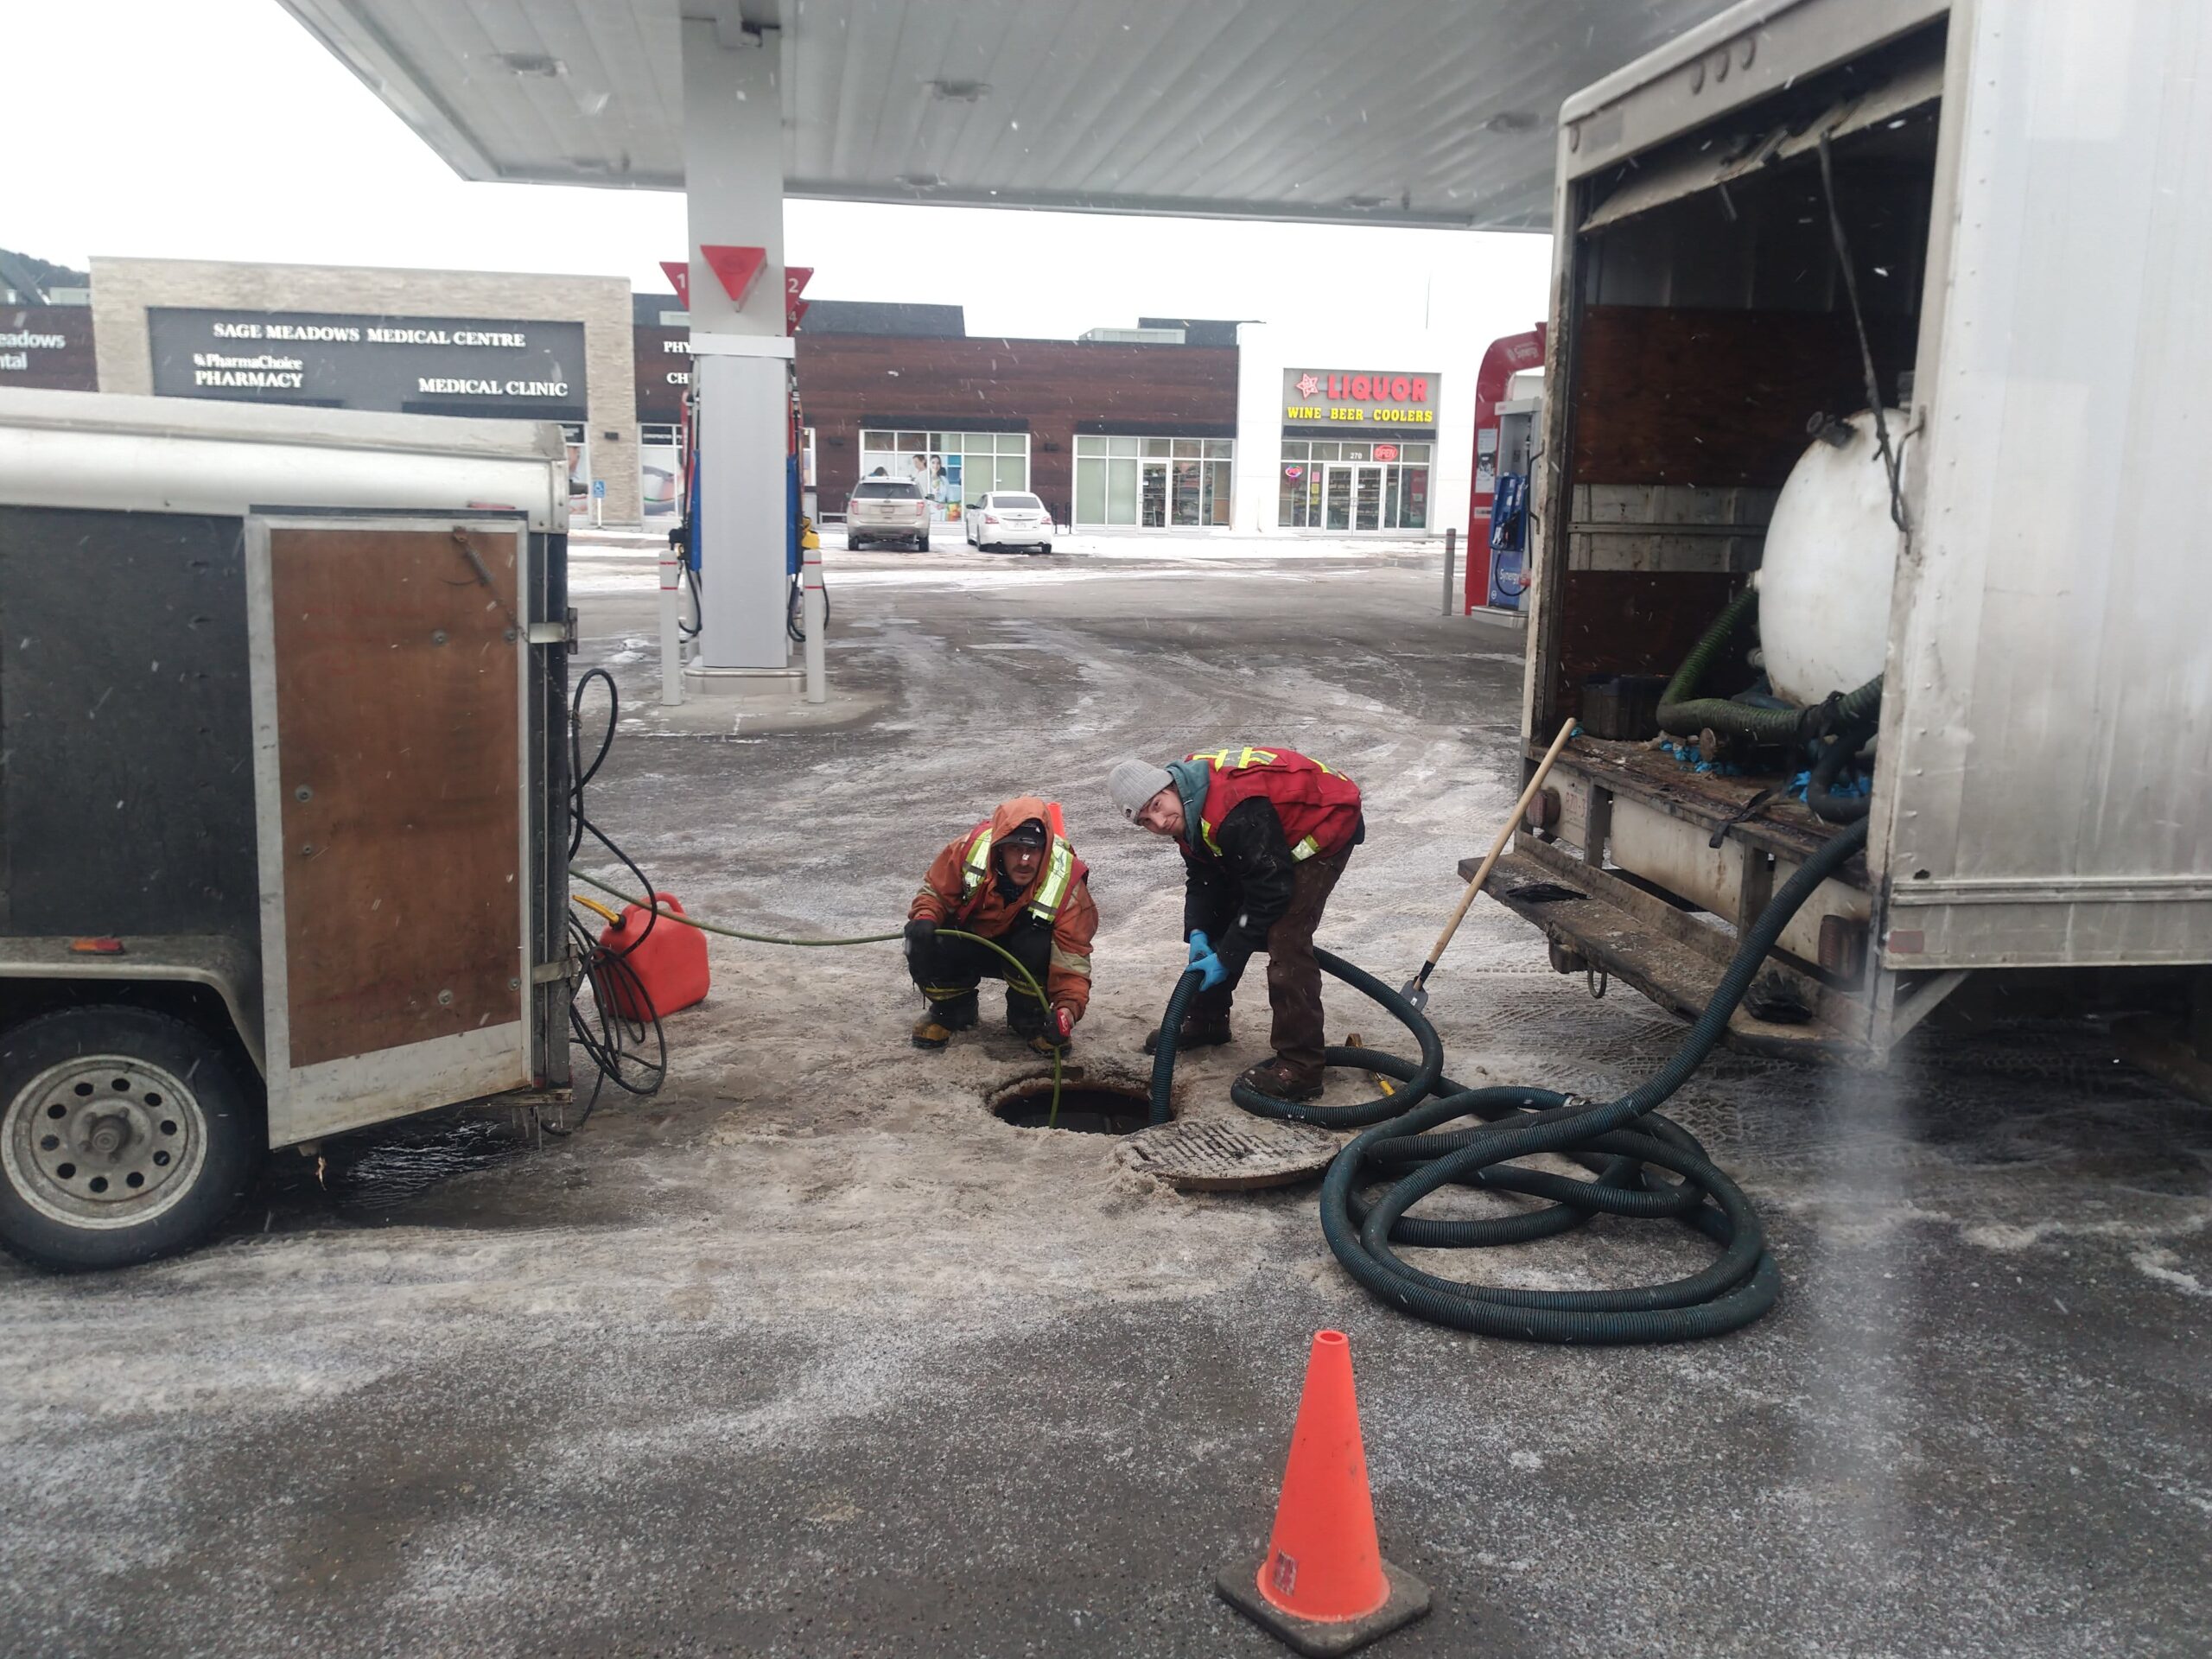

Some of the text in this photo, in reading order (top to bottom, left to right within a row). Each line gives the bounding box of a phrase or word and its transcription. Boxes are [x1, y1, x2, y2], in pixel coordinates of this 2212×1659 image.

[677, 273, 686, 289] 1
[788, 278, 798, 293] 2
[788, 310, 797, 322] 4
[213, 322, 526, 347] SAGE MEADOWS MEDICAL CENTRE
[206, 353, 303, 371] PharmaChoice
[194, 370, 304, 388] PHARMACY
[666, 372, 689, 385] CH
[418, 378, 568, 397] MEDICAL CLINIC
[1327, 375, 1428, 401] LIQUOR
[1287, 406, 1433, 423] WINE BEER COOLERS
